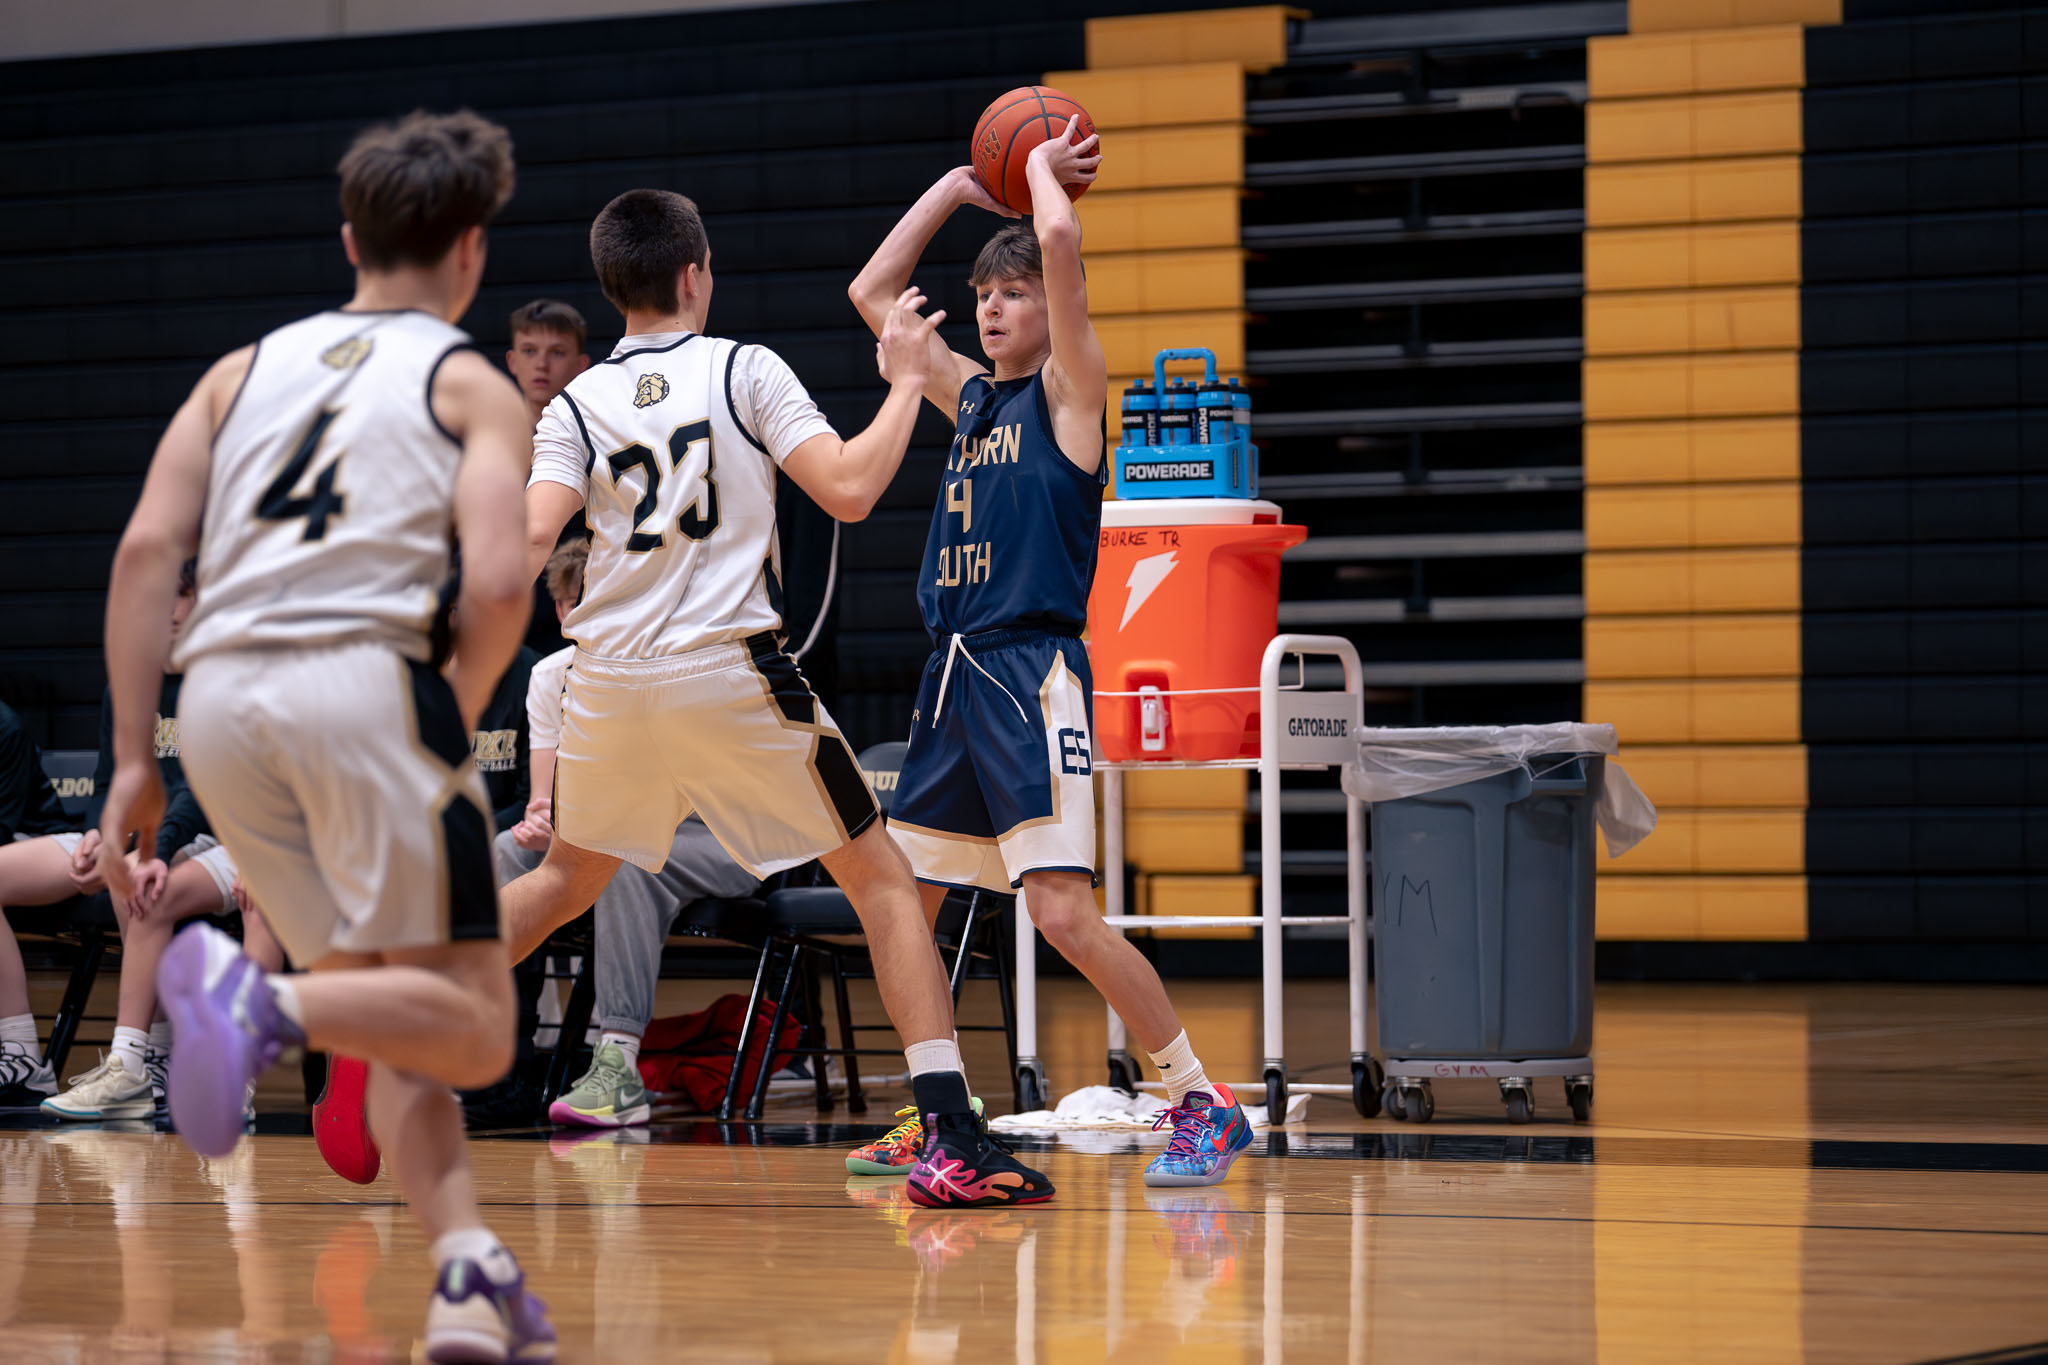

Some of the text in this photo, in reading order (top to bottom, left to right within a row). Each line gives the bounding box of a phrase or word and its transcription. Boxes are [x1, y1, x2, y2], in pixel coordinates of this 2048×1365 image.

[255, 404, 346, 543] 4
[1125, 462, 1212, 480] POWERADE
[606, 416, 722, 555] 23
[1100, 530, 1181, 548] BURKE TR
[1288, 717, 1348, 737] GATORADE
[1058, 727, 1091, 776] ES
[1434, 1063, 1490, 1078] GYM
